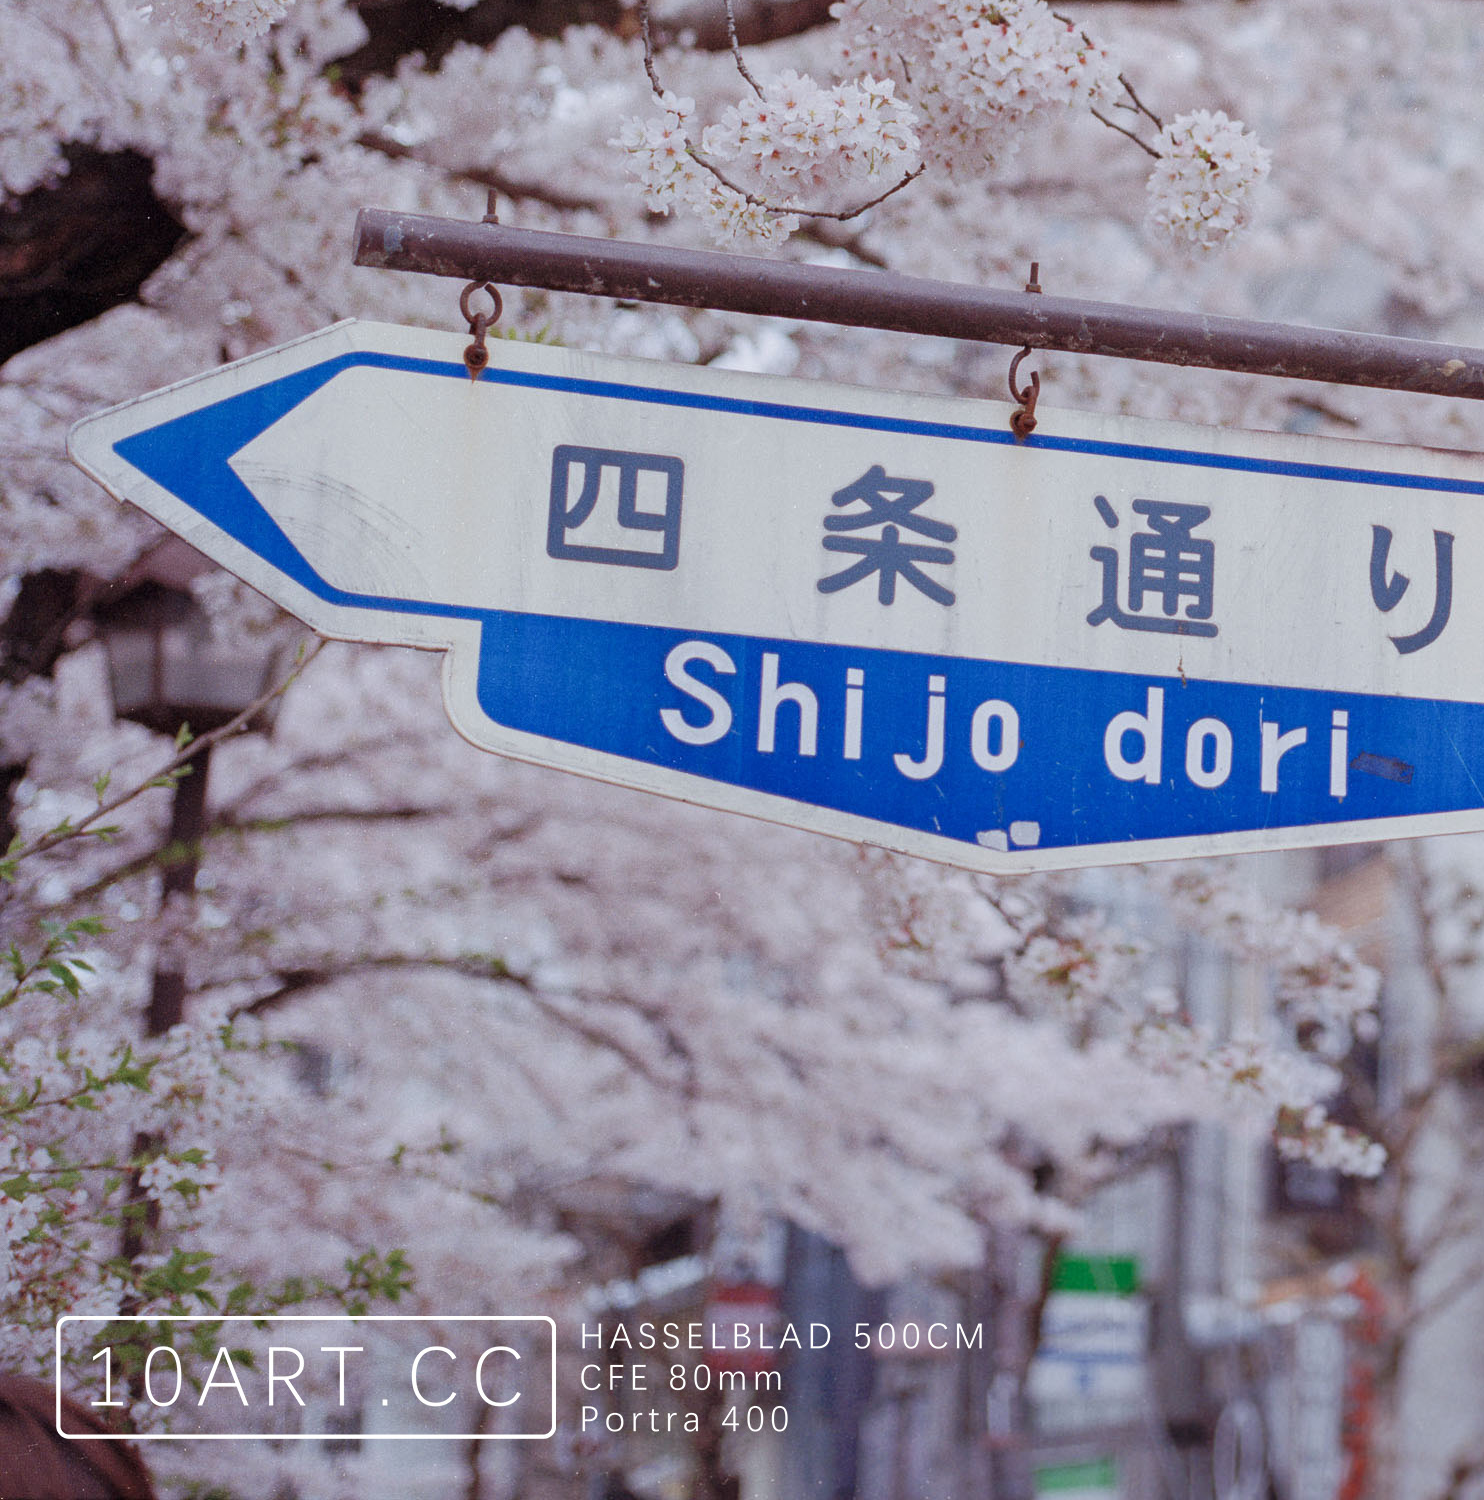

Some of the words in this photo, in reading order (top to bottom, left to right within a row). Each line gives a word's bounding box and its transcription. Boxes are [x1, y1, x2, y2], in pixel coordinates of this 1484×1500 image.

[546, 443, 1453, 654] 四条通り
[659, 640, 1020, 781] Shijo
[1103, 686, 1349, 798] dori
